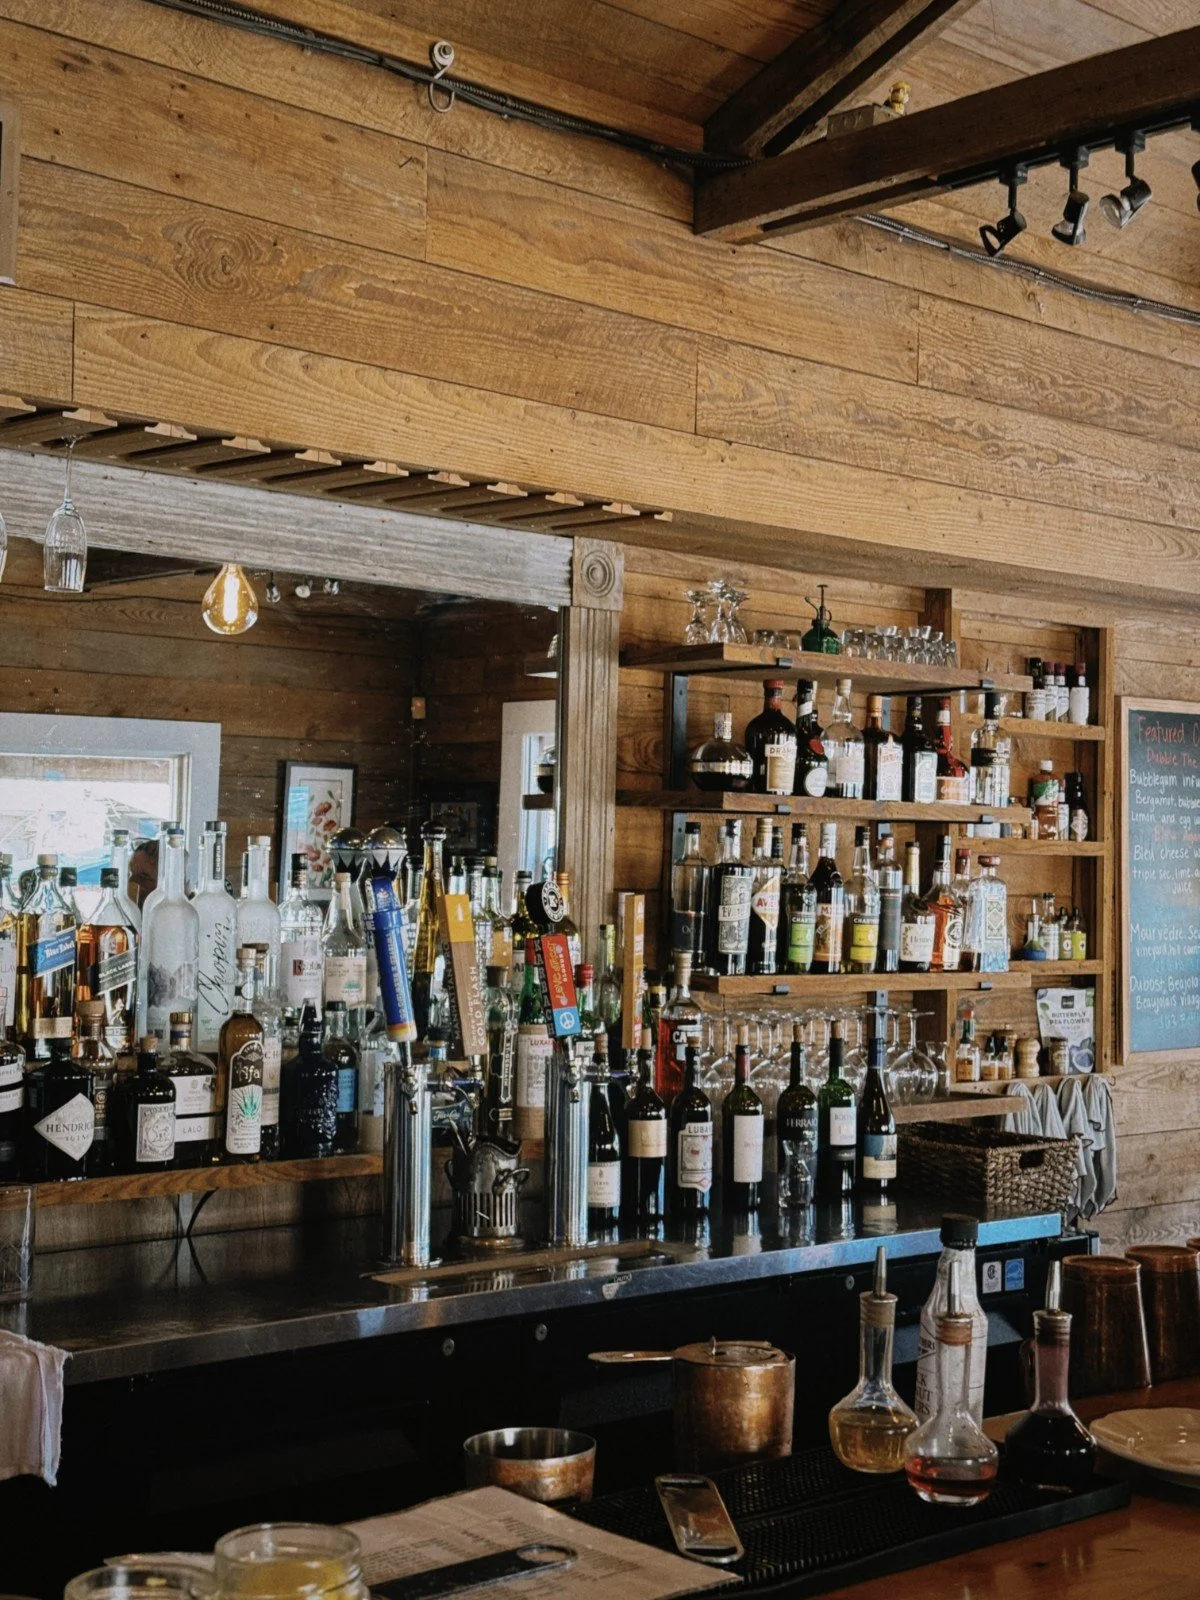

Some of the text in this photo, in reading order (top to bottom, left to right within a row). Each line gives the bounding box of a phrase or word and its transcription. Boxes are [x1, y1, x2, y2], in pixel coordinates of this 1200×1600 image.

[198, 920, 231, 1016] Chopin
[468, 966, 486, 1046] GOLD FLASH
[1051, 1011, 1087, 1019] BUTTERFLY
[182, 1124, 203, 1134] LALO
